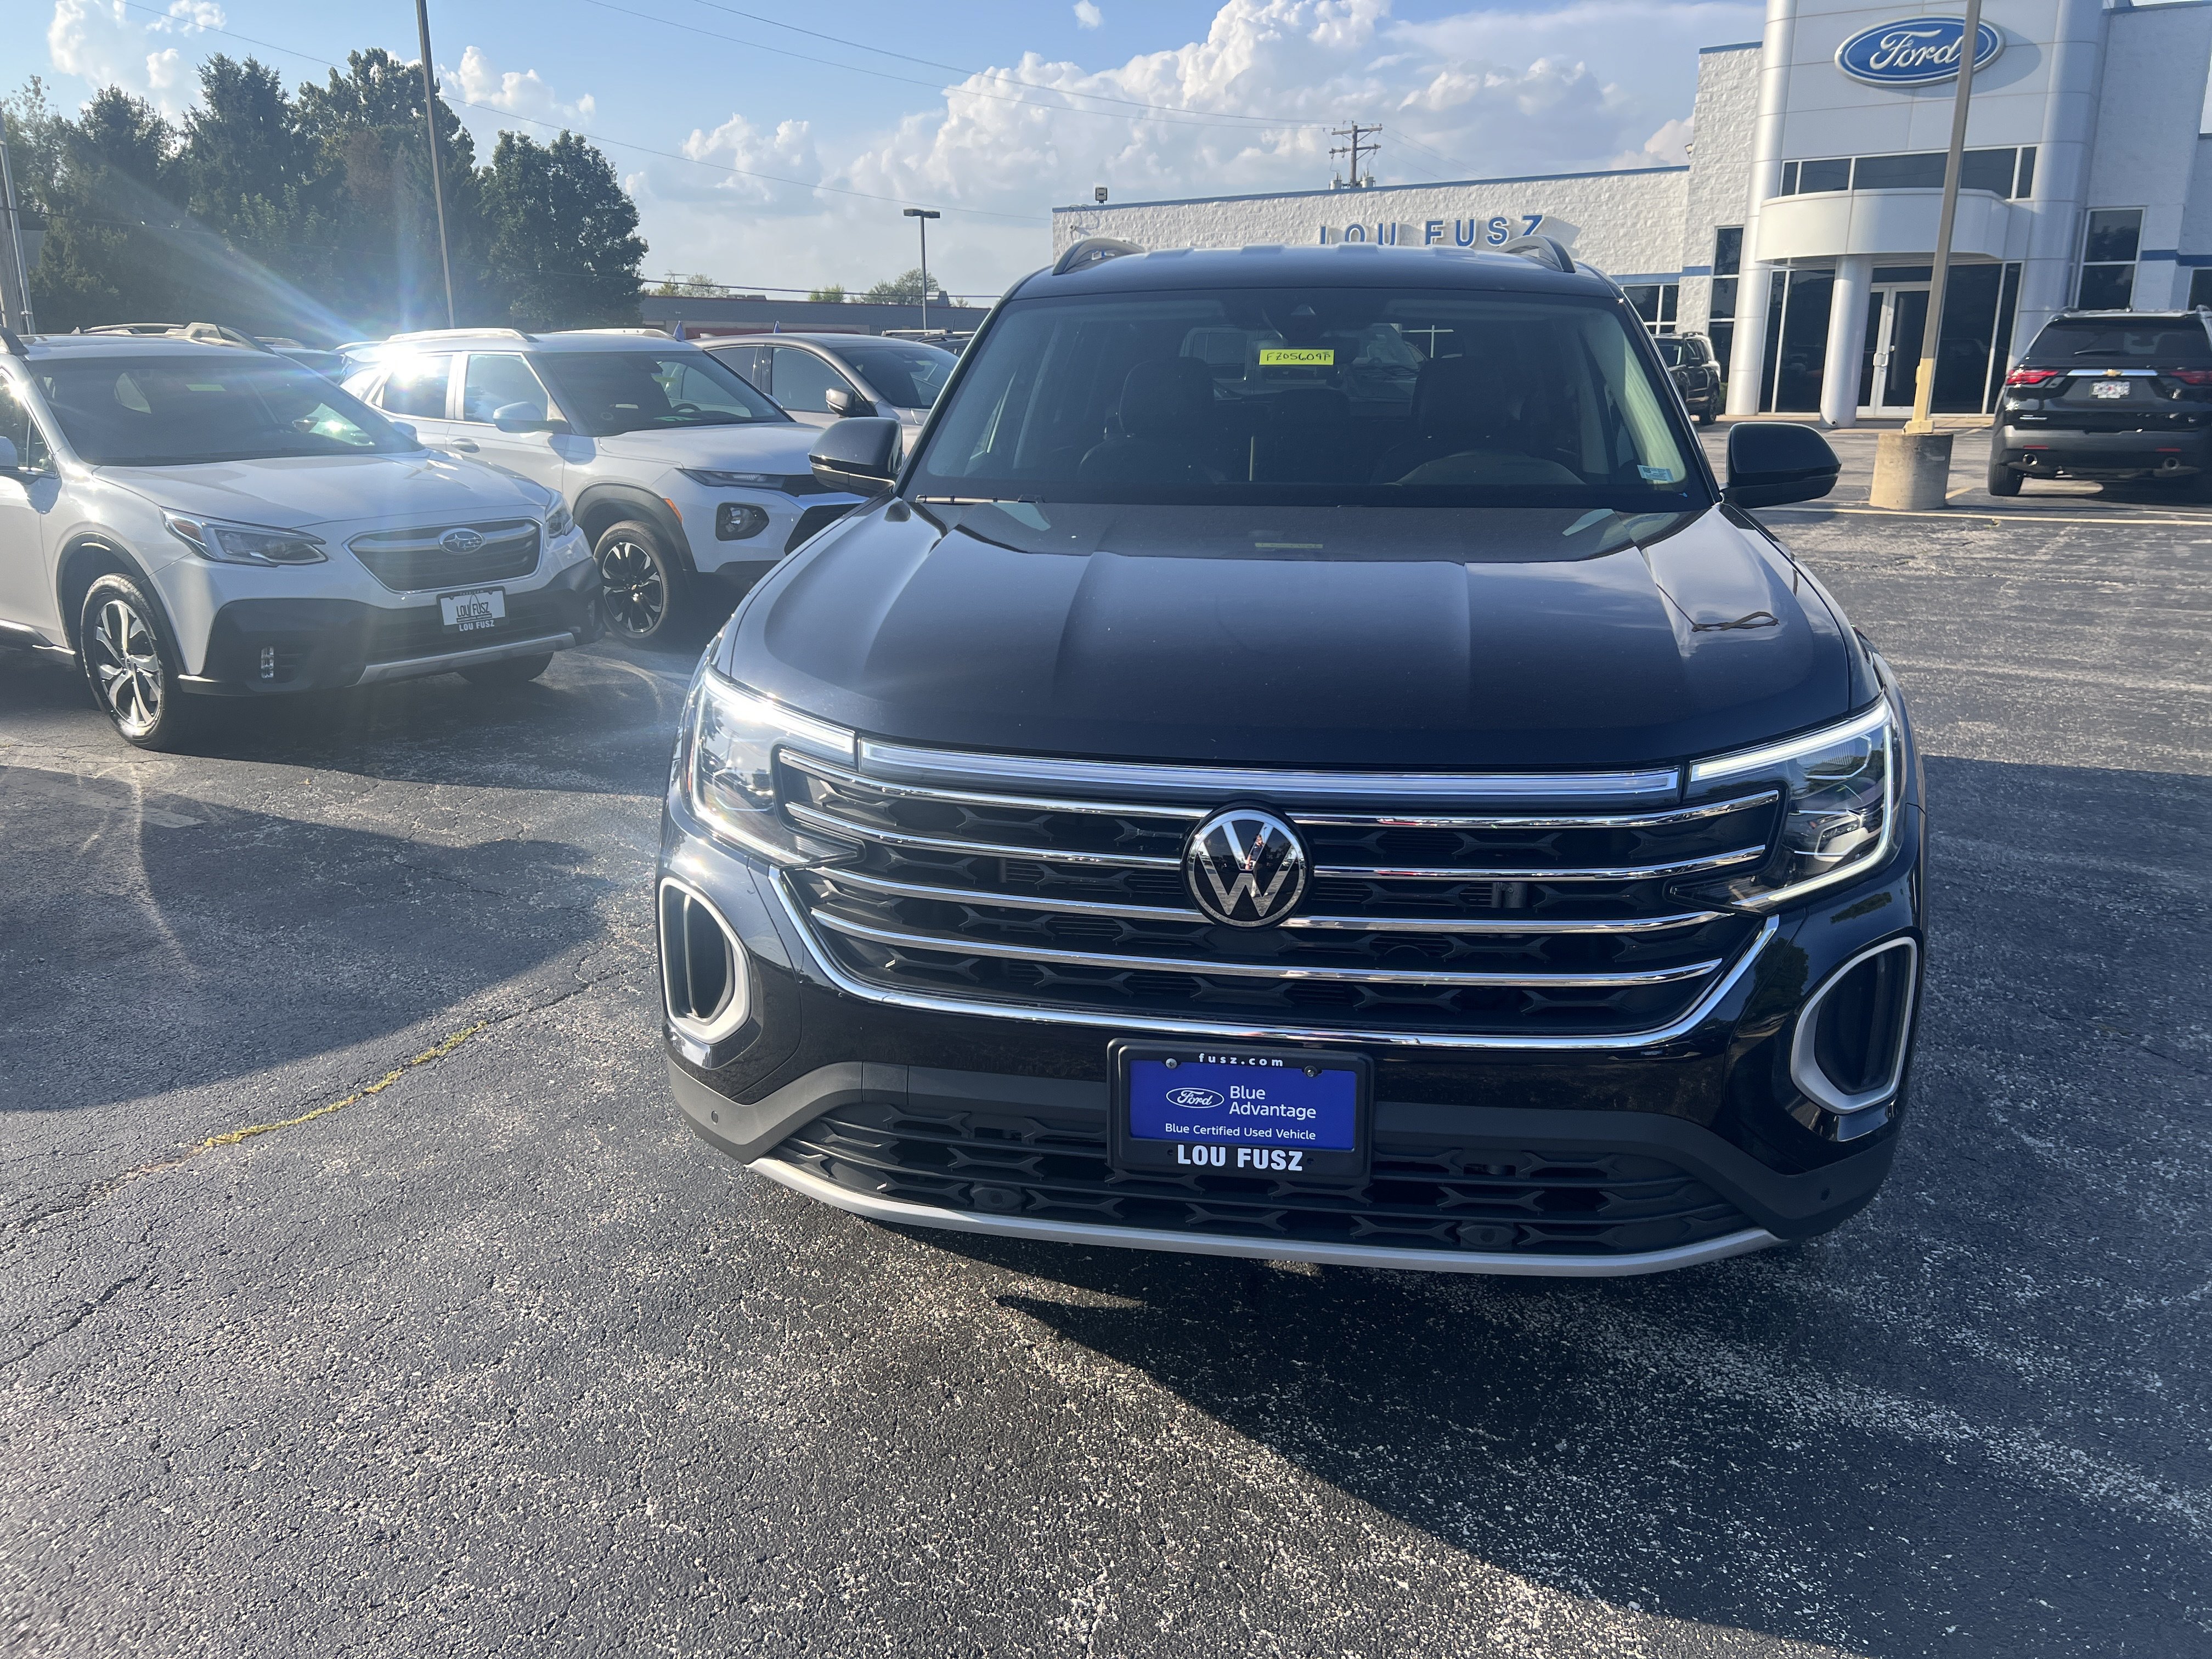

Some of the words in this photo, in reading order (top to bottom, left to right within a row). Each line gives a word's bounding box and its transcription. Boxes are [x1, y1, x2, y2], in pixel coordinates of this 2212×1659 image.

[1870, 28, 1965, 70] Ford
[1425, 213, 1545, 247] FUSZ
[456, 604, 469, 617] LOU
[472, 602, 490, 615] FUSZ
[459, 622, 473, 631] LOU
[476, 619, 495, 629] FUSZ
[1198, 1053, 1283, 1067] fusz.com
[1177, 1090, 1214, 1106] Ford
[1230, 1085, 1266, 1100] Blue
[1229, 1101, 1317, 1120] Advantage
[1165, 1123, 1190, 1133] Blue
[1193, 1125, 1240, 1137] Certified
[1244, 1127, 1272, 1138] Used
[1276, 1128, 1316, 1140] Vehicle
[1177, 1144, 1226, 1167] LOU
[1237, 1148, 1303, 1171] FUSZ
